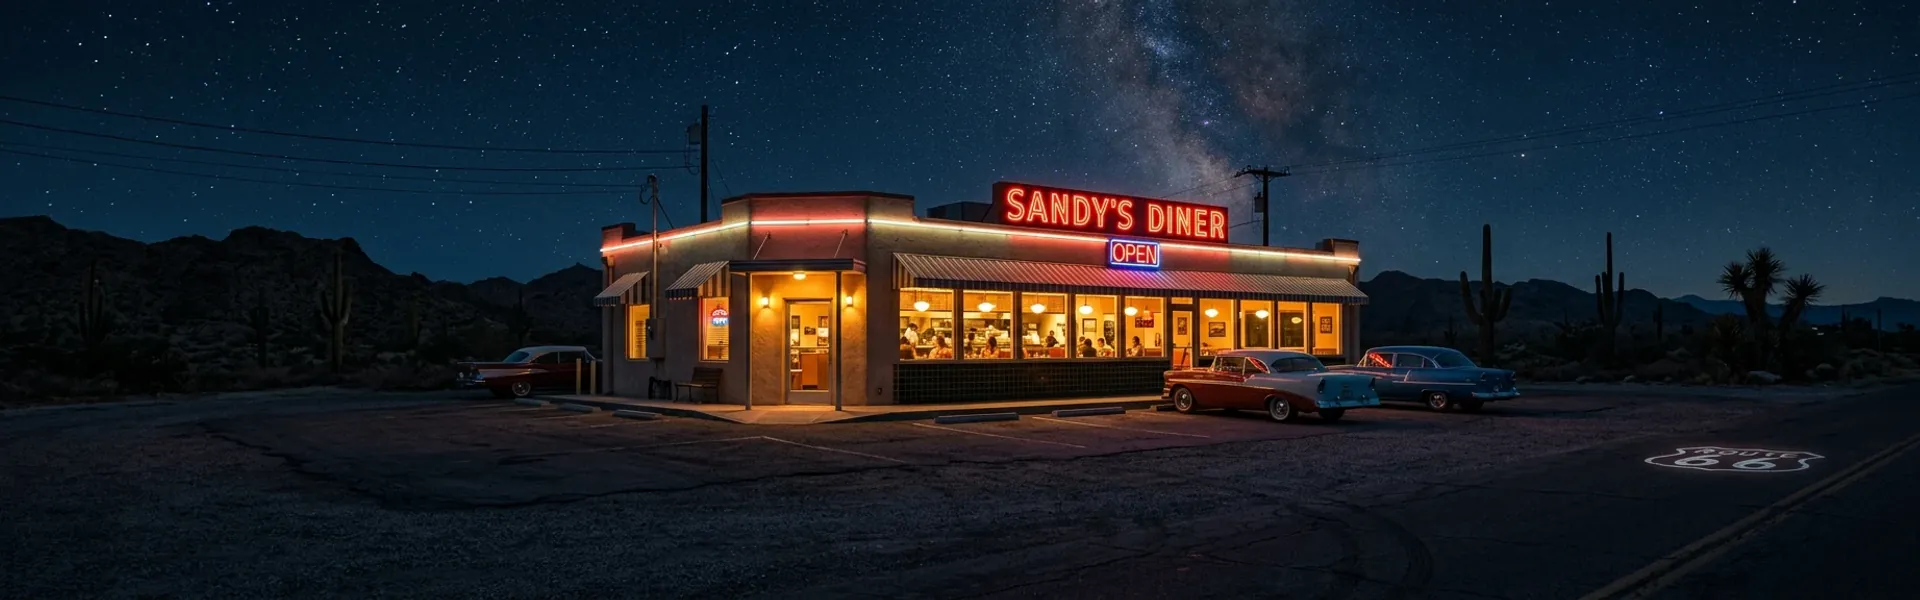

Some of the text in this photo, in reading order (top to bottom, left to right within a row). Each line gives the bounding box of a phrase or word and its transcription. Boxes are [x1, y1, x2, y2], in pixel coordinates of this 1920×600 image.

[1006, 188, 1225, 239] SANDY'S DINER
[1112, 243, 1157, 264] OPEN
[1674, 454, 1780, 470] 66
[1694, 448, 1799, 459] ROUTE
